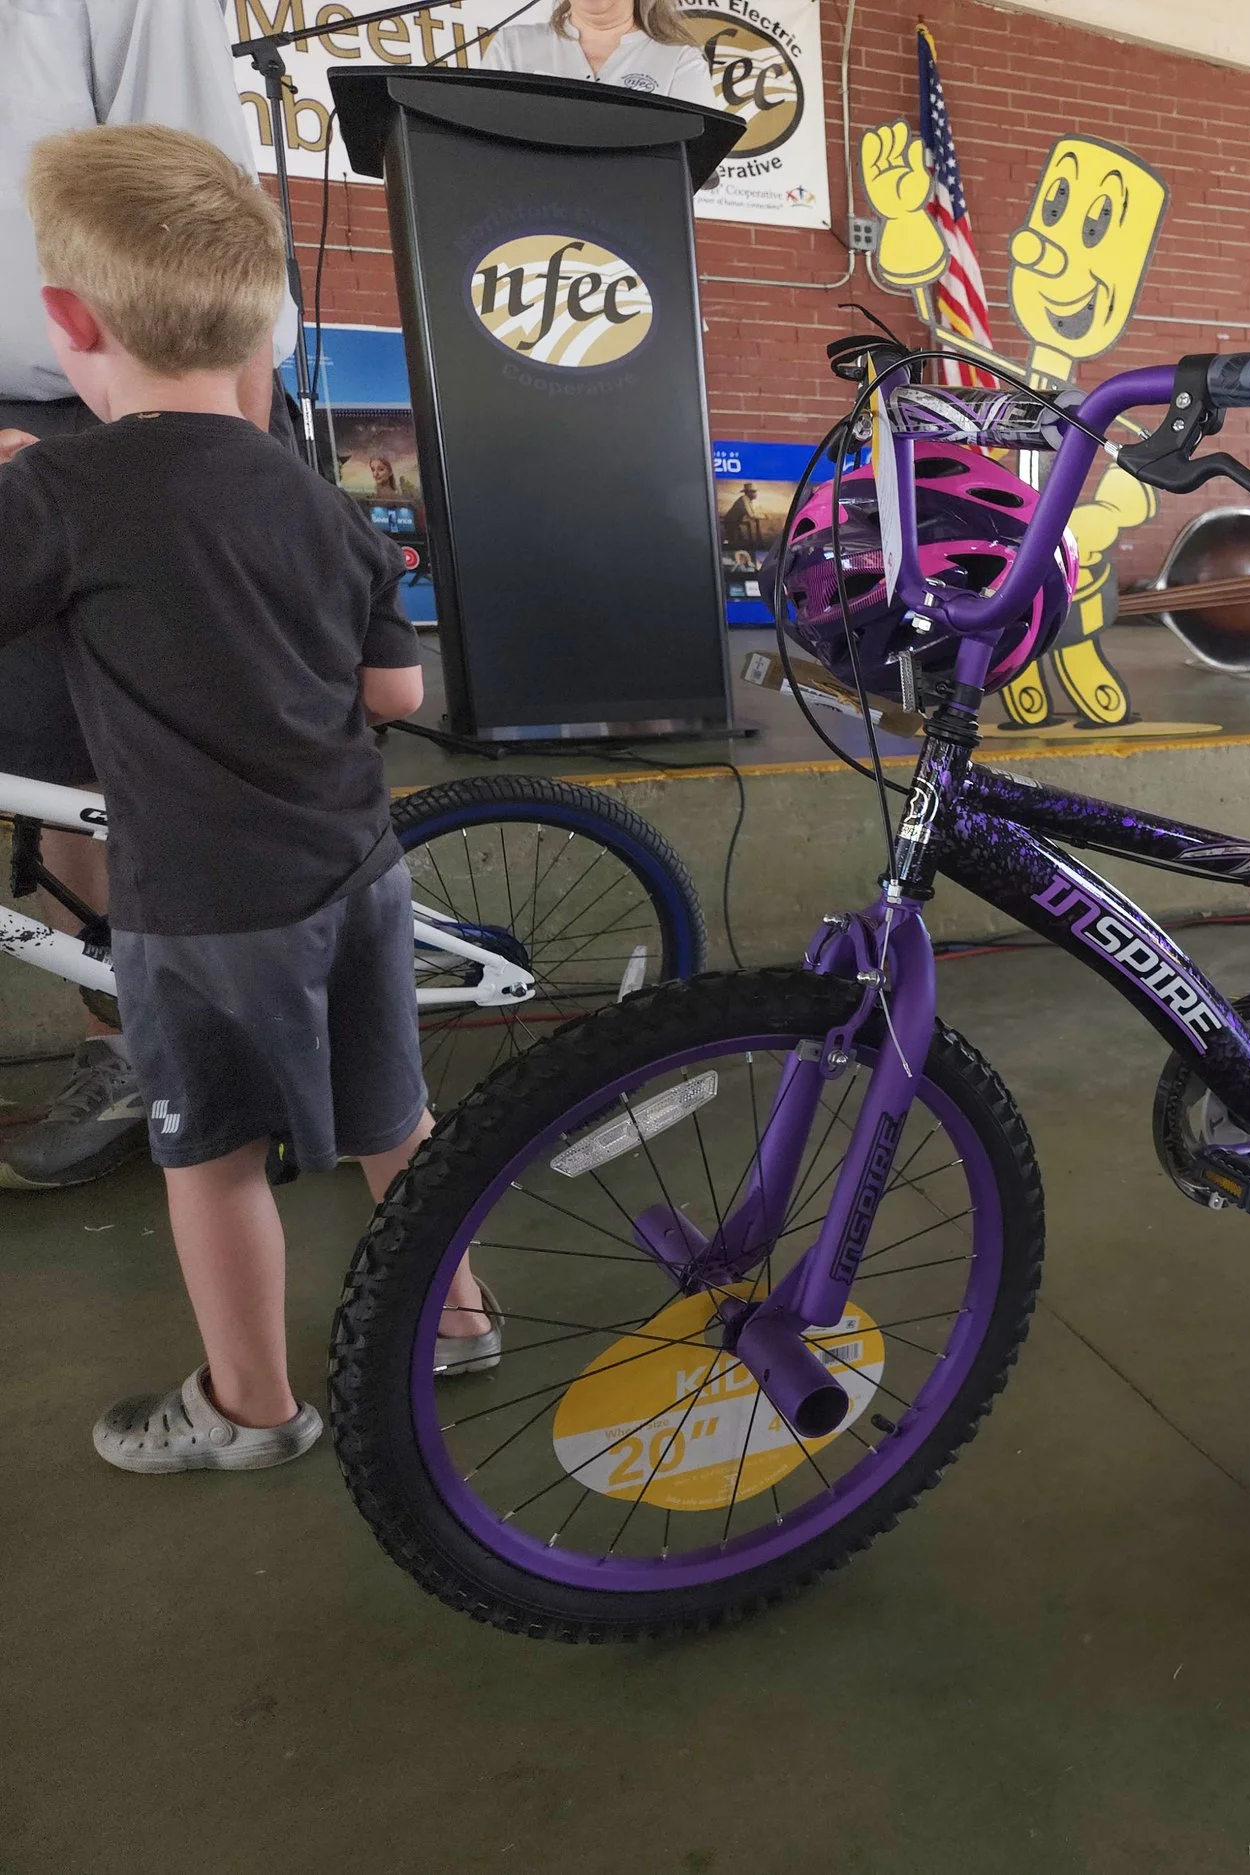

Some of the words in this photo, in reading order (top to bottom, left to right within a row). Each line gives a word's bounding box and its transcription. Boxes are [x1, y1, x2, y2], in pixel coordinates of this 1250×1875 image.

[729, 0, 802, 58] Electric
[719, 157, 784, 179] erative
[476, 241, 641, 351] nfec
[713, 458, 742, 473] ZIO
[675, 1358, 755, 1404] KID
